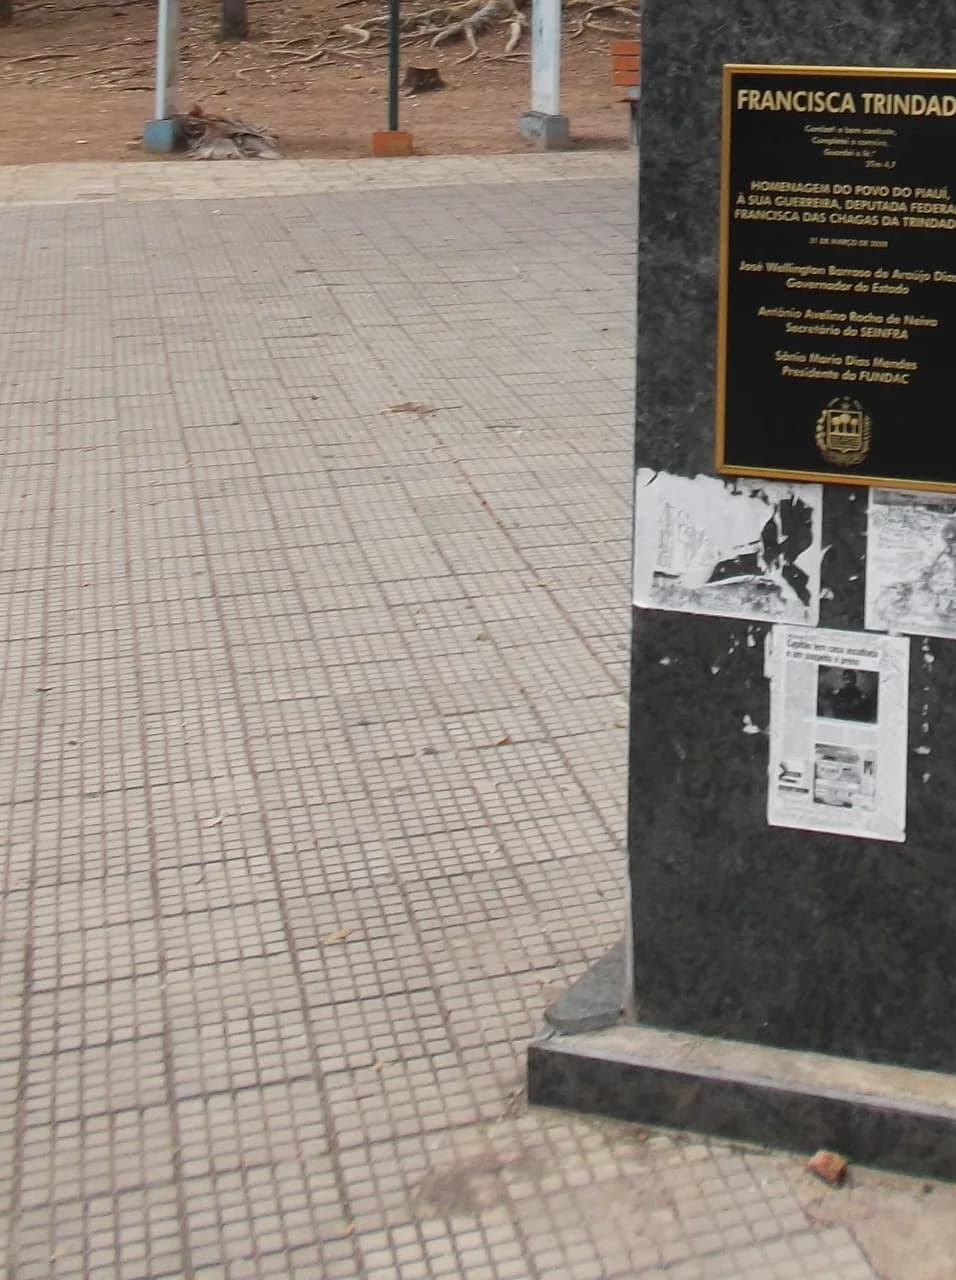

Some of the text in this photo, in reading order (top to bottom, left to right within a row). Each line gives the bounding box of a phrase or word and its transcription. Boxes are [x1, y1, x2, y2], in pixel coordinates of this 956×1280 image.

[737, 89, 855, 113] FRANCISCA
[750, 180, 830, 194] HOMENAGEM
[832, 184, 852, 195] DO
[854, 185, 889, 197] POVO
[892, 186, 912, 198] DO
[747, 195, 772, 206] SUA
[774, 196, 841, 210] GUERREIRA,
[845, 200, 908, 212] DEPUTADA
[734, 209, 799, 221] FRANCISCA
[802, 212, 827, 223] DAS
[829, 213, 879, 225] CHAGAS
[882, 216, 900, 226] DA
[739, 261, 763, 272] José
[828, 265, 871, 278] Barroso
[873, 267, 889, 278] de
[785, 277, 909, 294] Governador do Estado
[785, 321, 840, 335] Secretário
[860, 326, 908, 339] SEINFRA
[808, 352, 842, 364] Maria
[844, 355, 870, 366] Dias
[872, 356, 917, 369] Mendes
[782, 365, 838, 379] Presidente
[858, 370, 910, 384] FUNDAC
